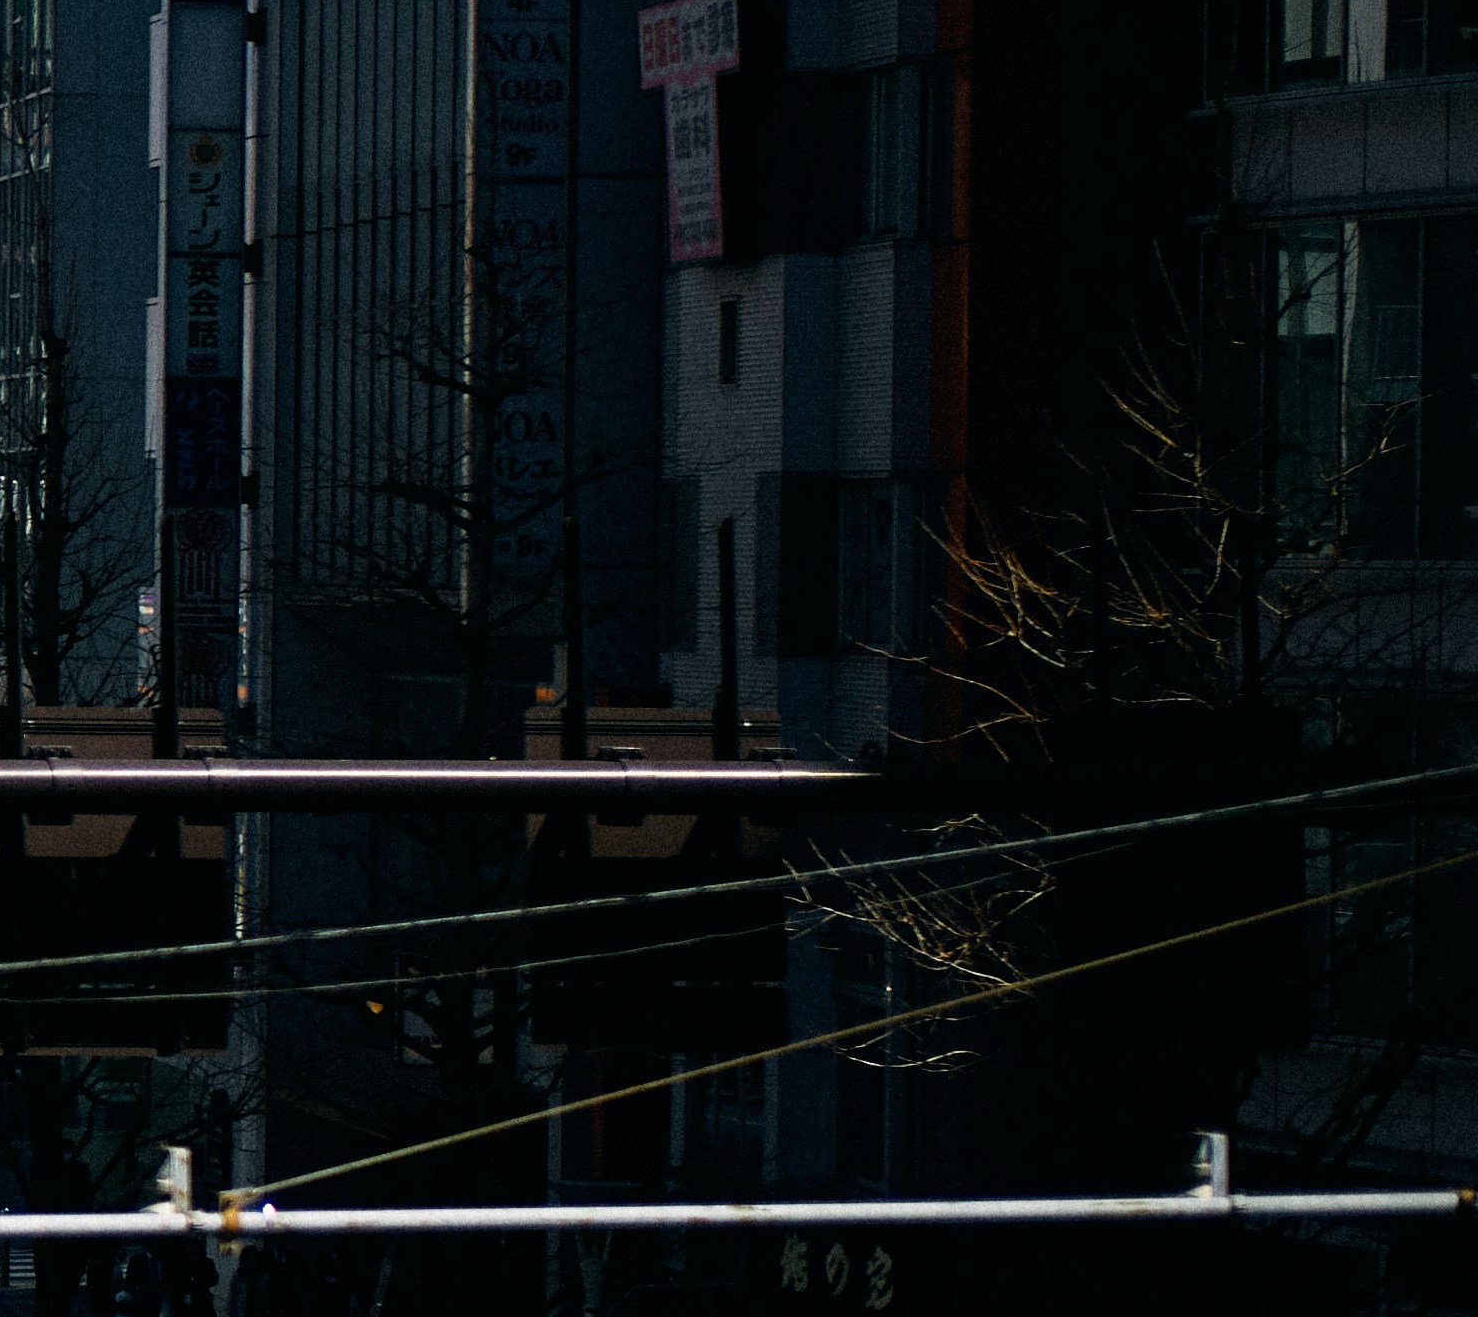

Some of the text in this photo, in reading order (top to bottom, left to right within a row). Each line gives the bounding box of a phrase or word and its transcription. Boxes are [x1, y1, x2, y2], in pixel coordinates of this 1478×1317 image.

[481, 32, 564, 63] NOA
[481, 71, 563, 106] Yoga
[188, 172, 221, 251] シェーン
[187, 260, 218, 349] 英会話
